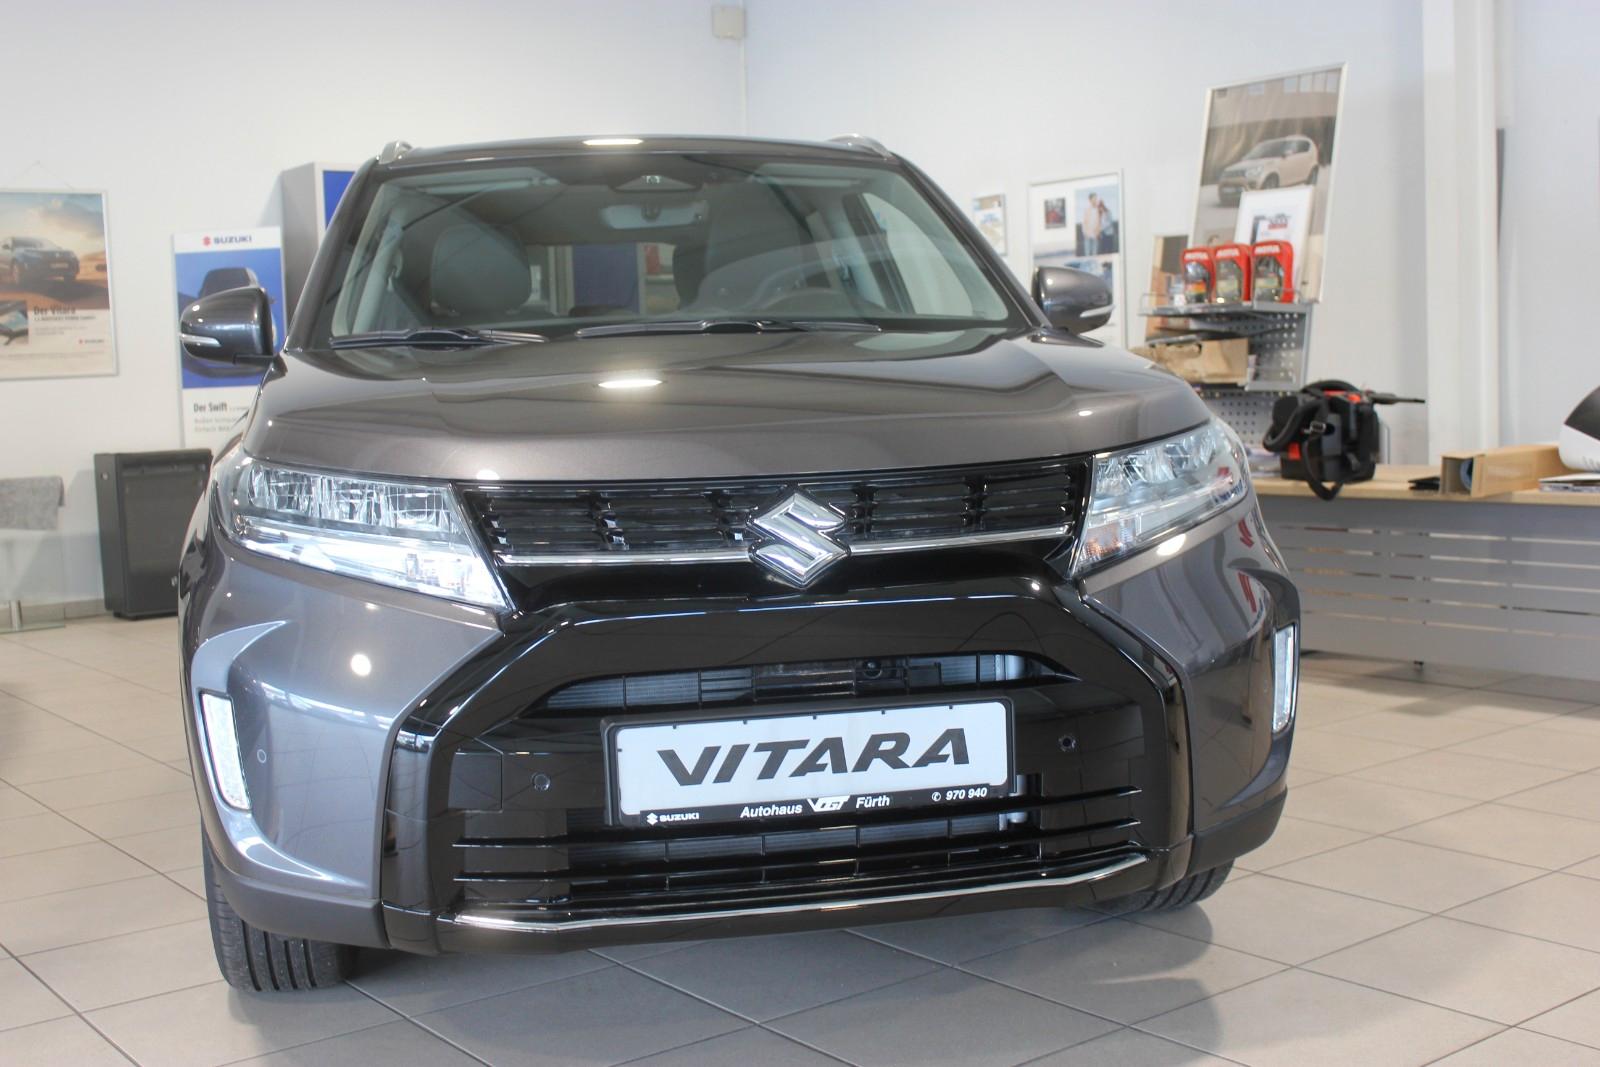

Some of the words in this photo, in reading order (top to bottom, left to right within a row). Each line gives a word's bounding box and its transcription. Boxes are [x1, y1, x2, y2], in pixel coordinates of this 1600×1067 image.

[193, 402, 206, 412] Der
[208, 401, 228, 412] Swift
[656, 728, 969, 786] VITARA
[945, 789, 966, 801] 970
[968, 787, 988, 799] 940
[740, 804, 803, 819] Autohaus
[856, 795, 890, 809] Fürth
[659, 811, 700, 822] SUZUKI
